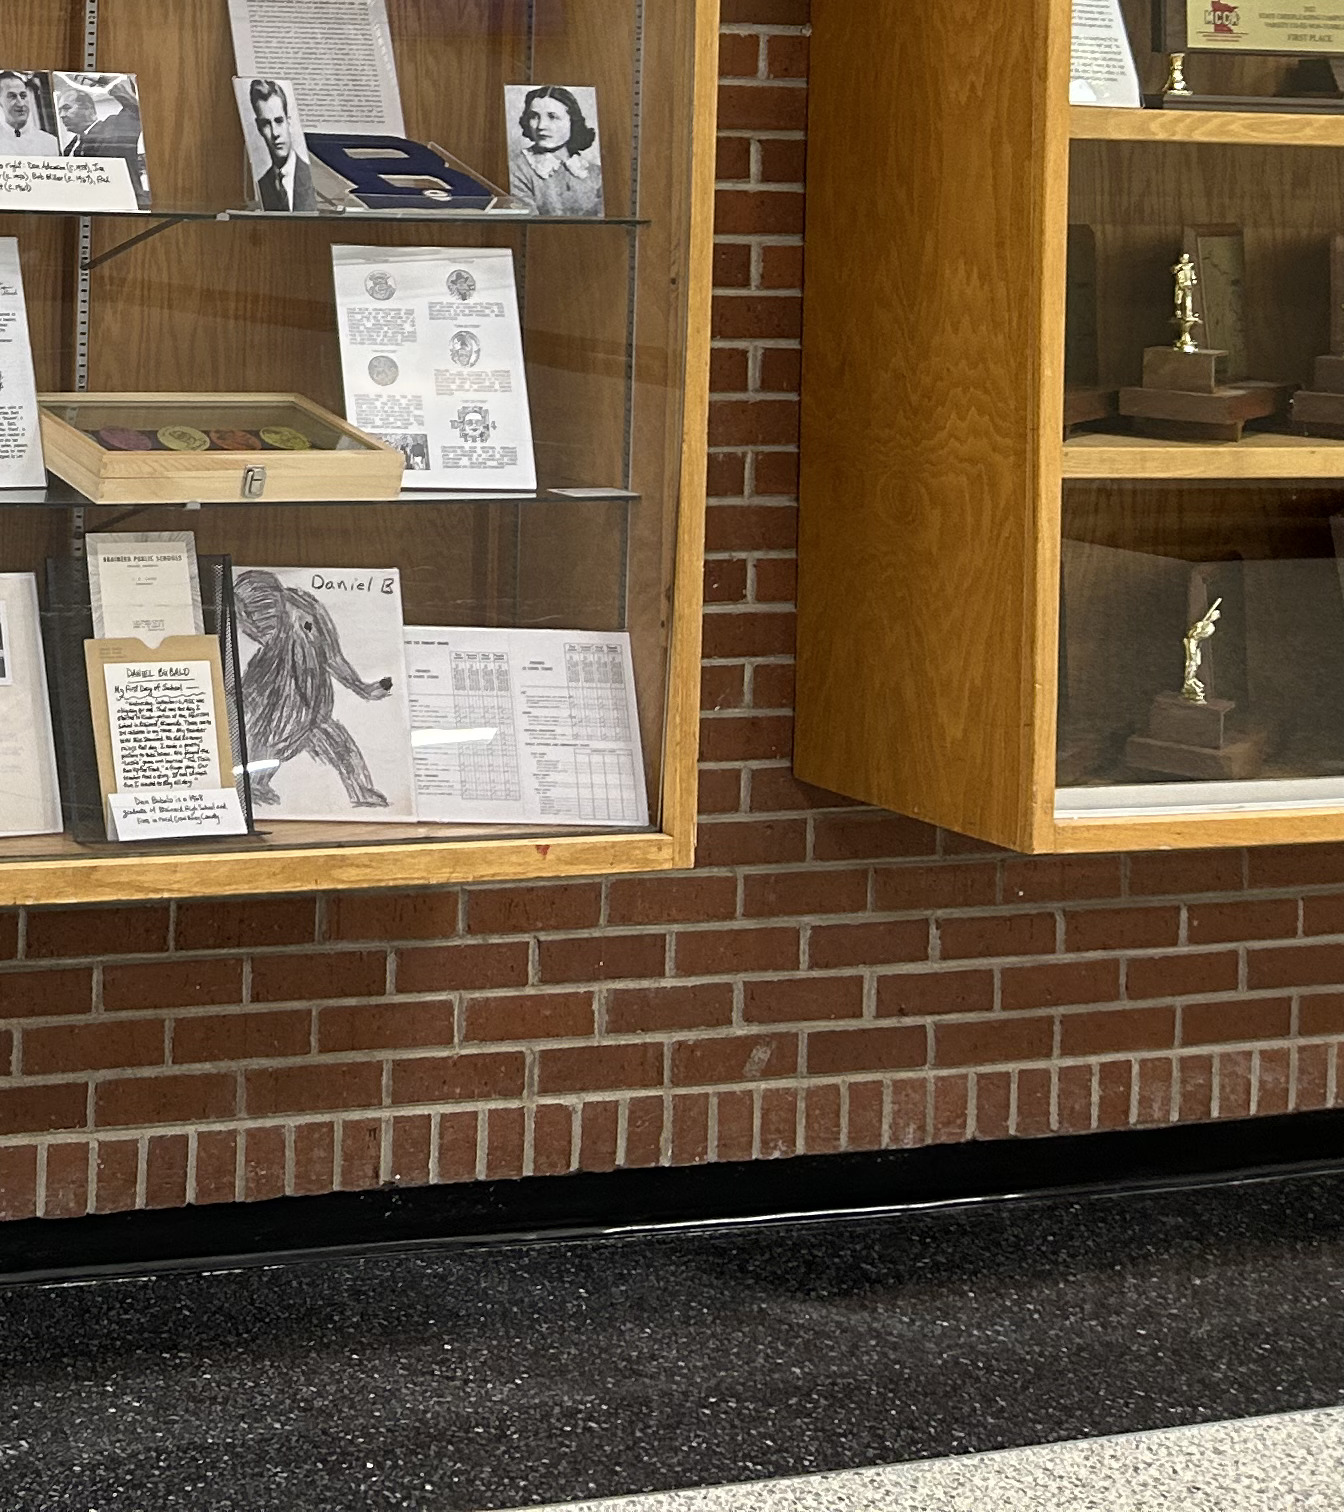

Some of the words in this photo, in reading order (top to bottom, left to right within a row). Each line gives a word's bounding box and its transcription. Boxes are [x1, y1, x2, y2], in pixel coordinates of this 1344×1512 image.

[1204, 9, 1240, 26] MCCA
[1287, 33, 1309, 41] FIRST
[1308, 34, 1333, 42] PLACE
[102, 554, 132, 563] BRAINERD
[133, 554, 154, 562] PUBLIC
[155, 553, 183, 562] SCHOOLS
[311, 574, 374, 592] Daniel
[380, 577, 395, 594] B
[126, 667, 155, 678] DANIEL
[114, 685, 125, 701] My
[125, 684, 139, 693] First
[139, 685, 153, 697] Day
[161, 682, 183, 692] School
[134, 796, 150, 806] Dan
